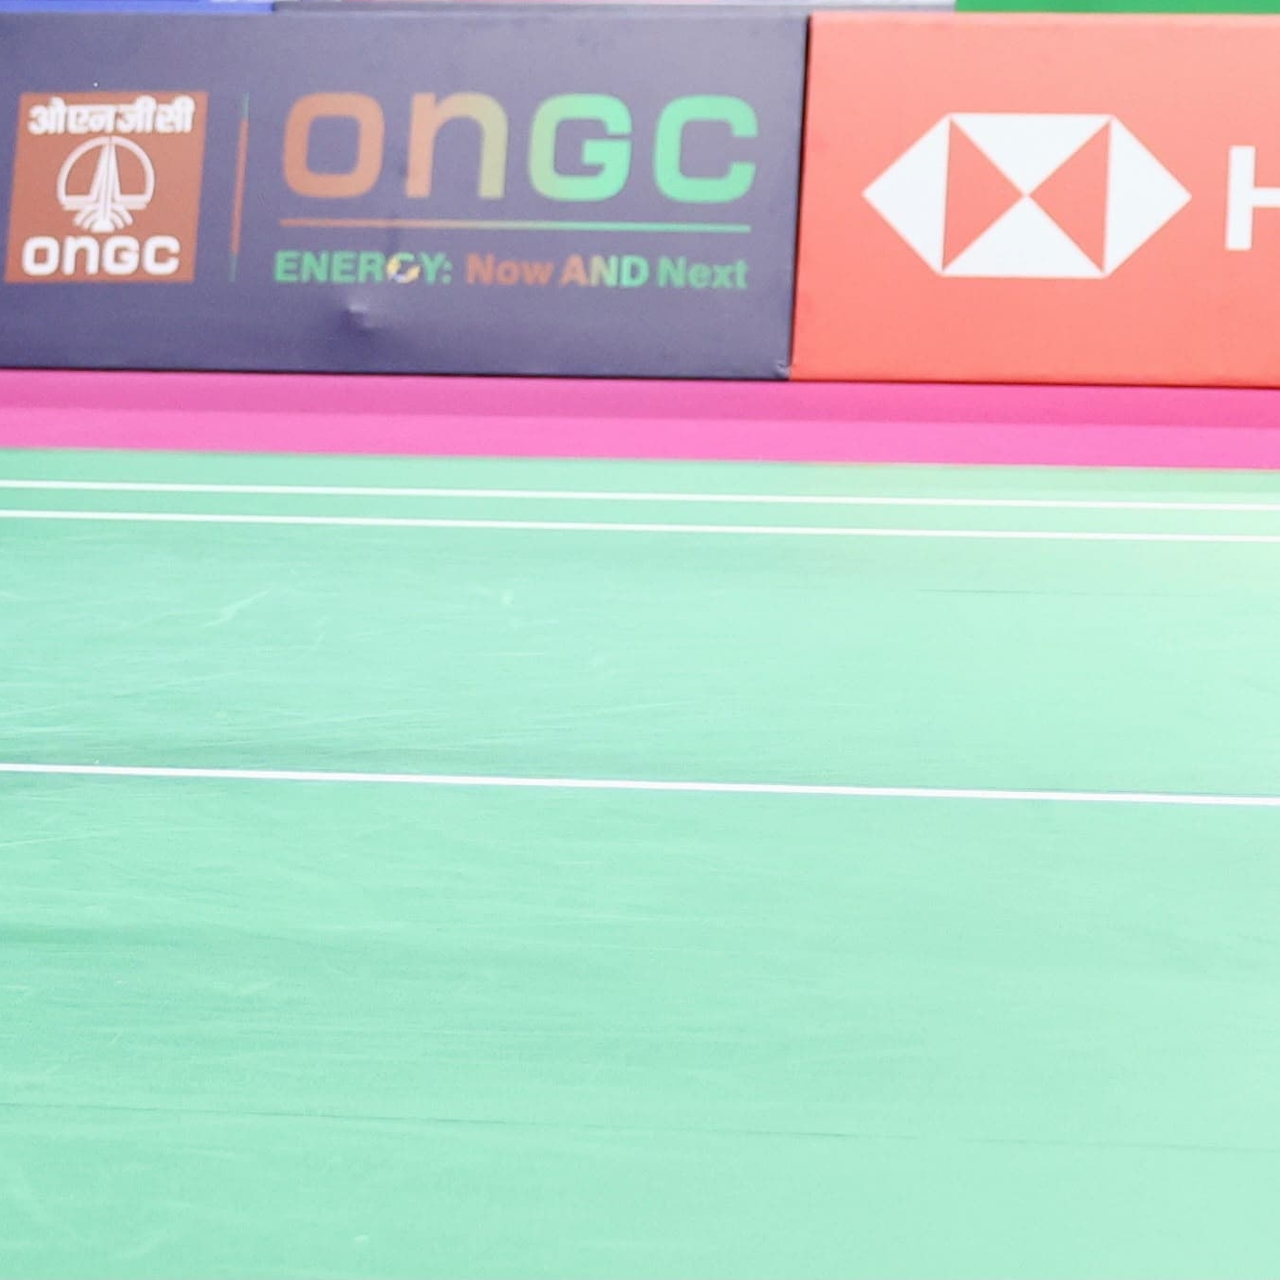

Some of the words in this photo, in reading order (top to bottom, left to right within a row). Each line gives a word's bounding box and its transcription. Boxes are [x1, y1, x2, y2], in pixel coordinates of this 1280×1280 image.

[466, 253, 552, 285] Now
[560, 255, 650, 287] AND
[658, 257, 749, 289] Next
